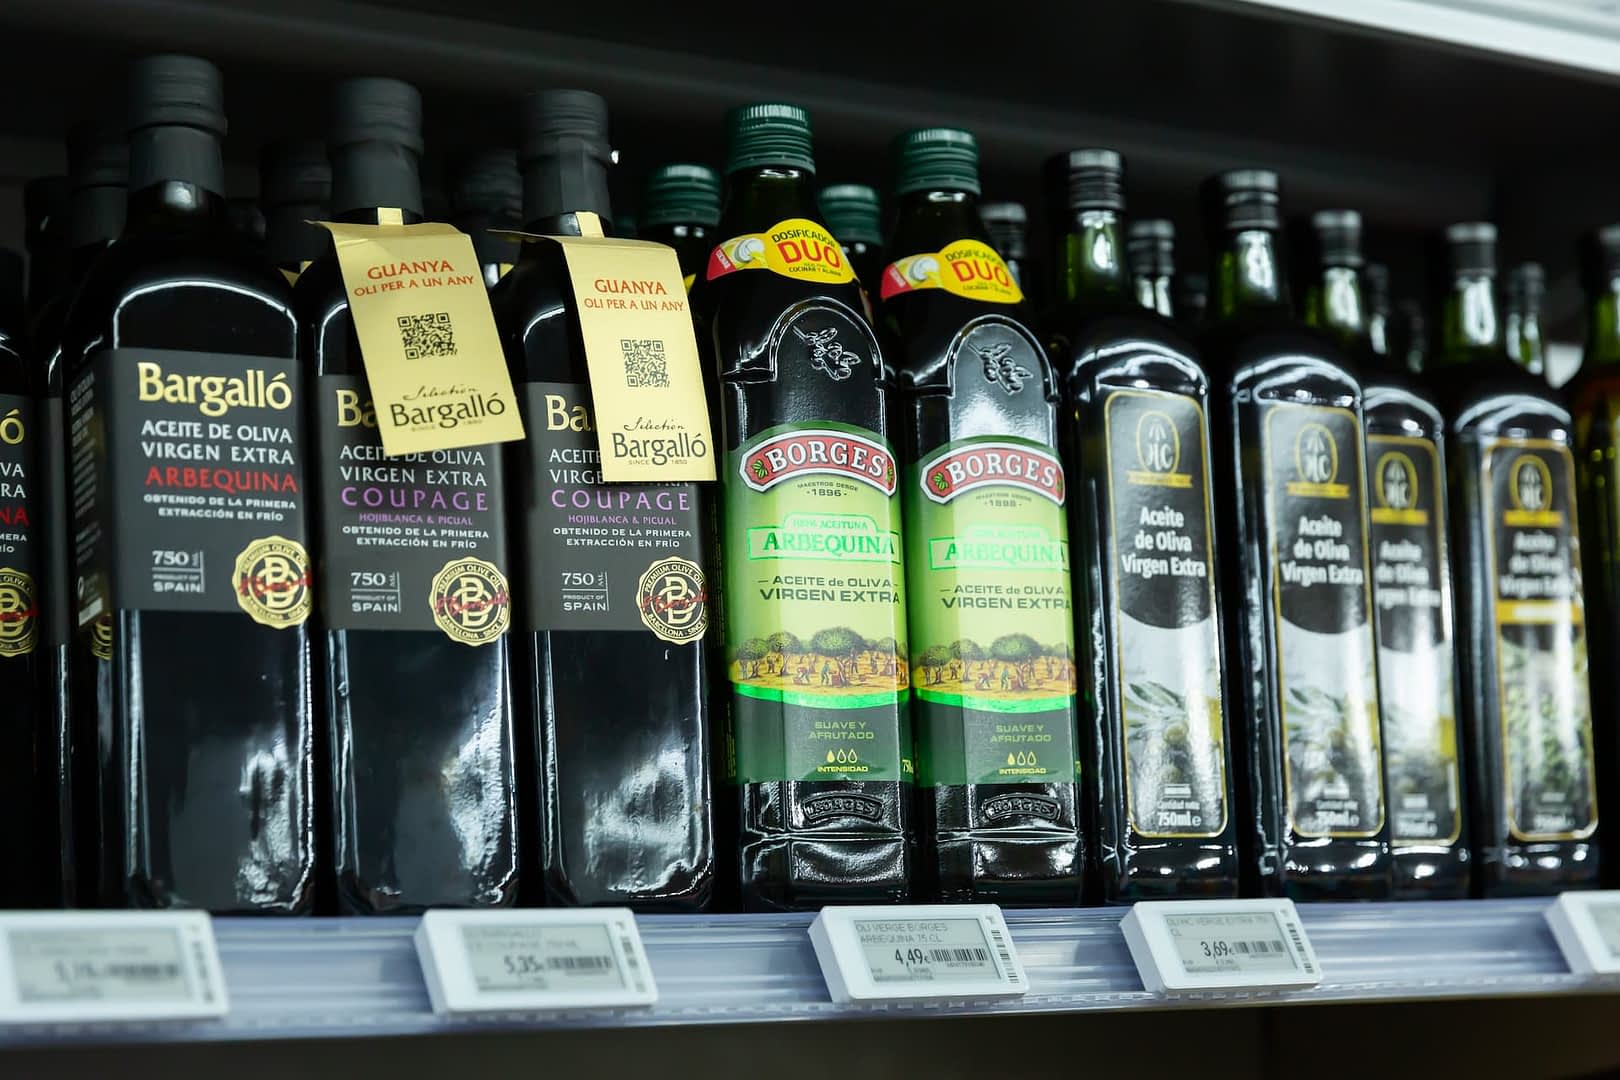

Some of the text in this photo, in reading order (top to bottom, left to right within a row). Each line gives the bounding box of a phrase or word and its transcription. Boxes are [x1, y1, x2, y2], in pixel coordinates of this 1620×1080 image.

[778, 239, 841, 268] DUO
[367, 260, 455, 280] GUANYA
[950, 259, 1010, 287] DUO
[354, 275, 474, 297] OLI PER A UN ANY
[595, 279, 668, 295] GUANYA
[584, 298, 684, 311] OLI PER A UN ANY
[137, 361, 293, 417] Bargalló
[390, 392, 505, 429] Bargalló
[141, 420, 293, 443] ACEITE DE OLIVA
[141, 441, 294, 465] VIRGEN EXTRA
[612, 432, 707, 465] Bargalló
[405, 451, 427, 463] DE
[431, 448, 486, 466] OLIVA
[765, 440, 886, 478] BORGES
[340, 466, 487, 487] VIRGEN EXTRA
[549, 469, 605, 485] VIRGE
[944, 452, 1057, 488] BORGES
[144, 465, 298, 494] ARBEQUINA
[797, 481, 834, 489] MAESTROS
[143, 493, 296, 509] OBTENIDO DE LA PRIMERA
[341, 486, 488, 511] COUPAGE
[551, 489, 691, 511] COUPAGE
[158, 507, 234, 520] EXTRACCIÓN
[237, 509, 254, 521] EN
[359, 512, 473, 526] HOJIBLANCA & PICUAL
[568, 515, 677, 526] HOJIBLANCA & PICUAL
[1140, 505, 1185, 528] Aceite
[342, 525, 489, 539] OBTENIDO DE LA PRIMERA
[819, 519, 868, 530] ACEITUNA
[553, 527, 692, 539] OBTENIDO DE LA PRIMERA
[1135, 529, 1192, 552] de Oliva
[356, 537, 429, 549] EXTRACCIÓN
[432, 539, 448, 549] EN
[566, 537, 635, 547] EXTRACCIÓN
[638, 539, 652, 548] EN
[763, 532, 895, 556] ARBEQUINA
[152, 551, 191, 567] 750
[1121, 553, 1206, 579] Virgen Extra
[350, 572, 386, 586] 750
[466, 564, 491, 576] OLIVE
[490, 573, 502, 588] OIL
[561, 572, 595, 586] 750
[644, 564, 705, 593] PREMIUM OLIVE OIL
[772, 575, 892, 588] ACEITE de OLIVA
[153, 581, 202, 593] SPAIN
[954, 584, 1065, 595] ACEITE de OLIVA
[760, 588, 901, 604] VIRGEN EXTRA
[941, 597, 1013, 609] VIRGEN
[352, 602, 398, 612] SPAIN
[563, 602, 606, 612] SPAIN
[647, 613, 684, 638] BARCELONA
[687, 622, 704, 636] SINCE
[814, 721, 867, 731] SUAVE Y
[996, 724, 1045, 733] SUAVE Y
[808, 731, 875, 740] AFRUTADO
[990, 734, 1052, 743] AFRUTADO
[999, 767, 1047, 775] INTENSIDAD
[1157, 811, 1192, 826] 750ml
